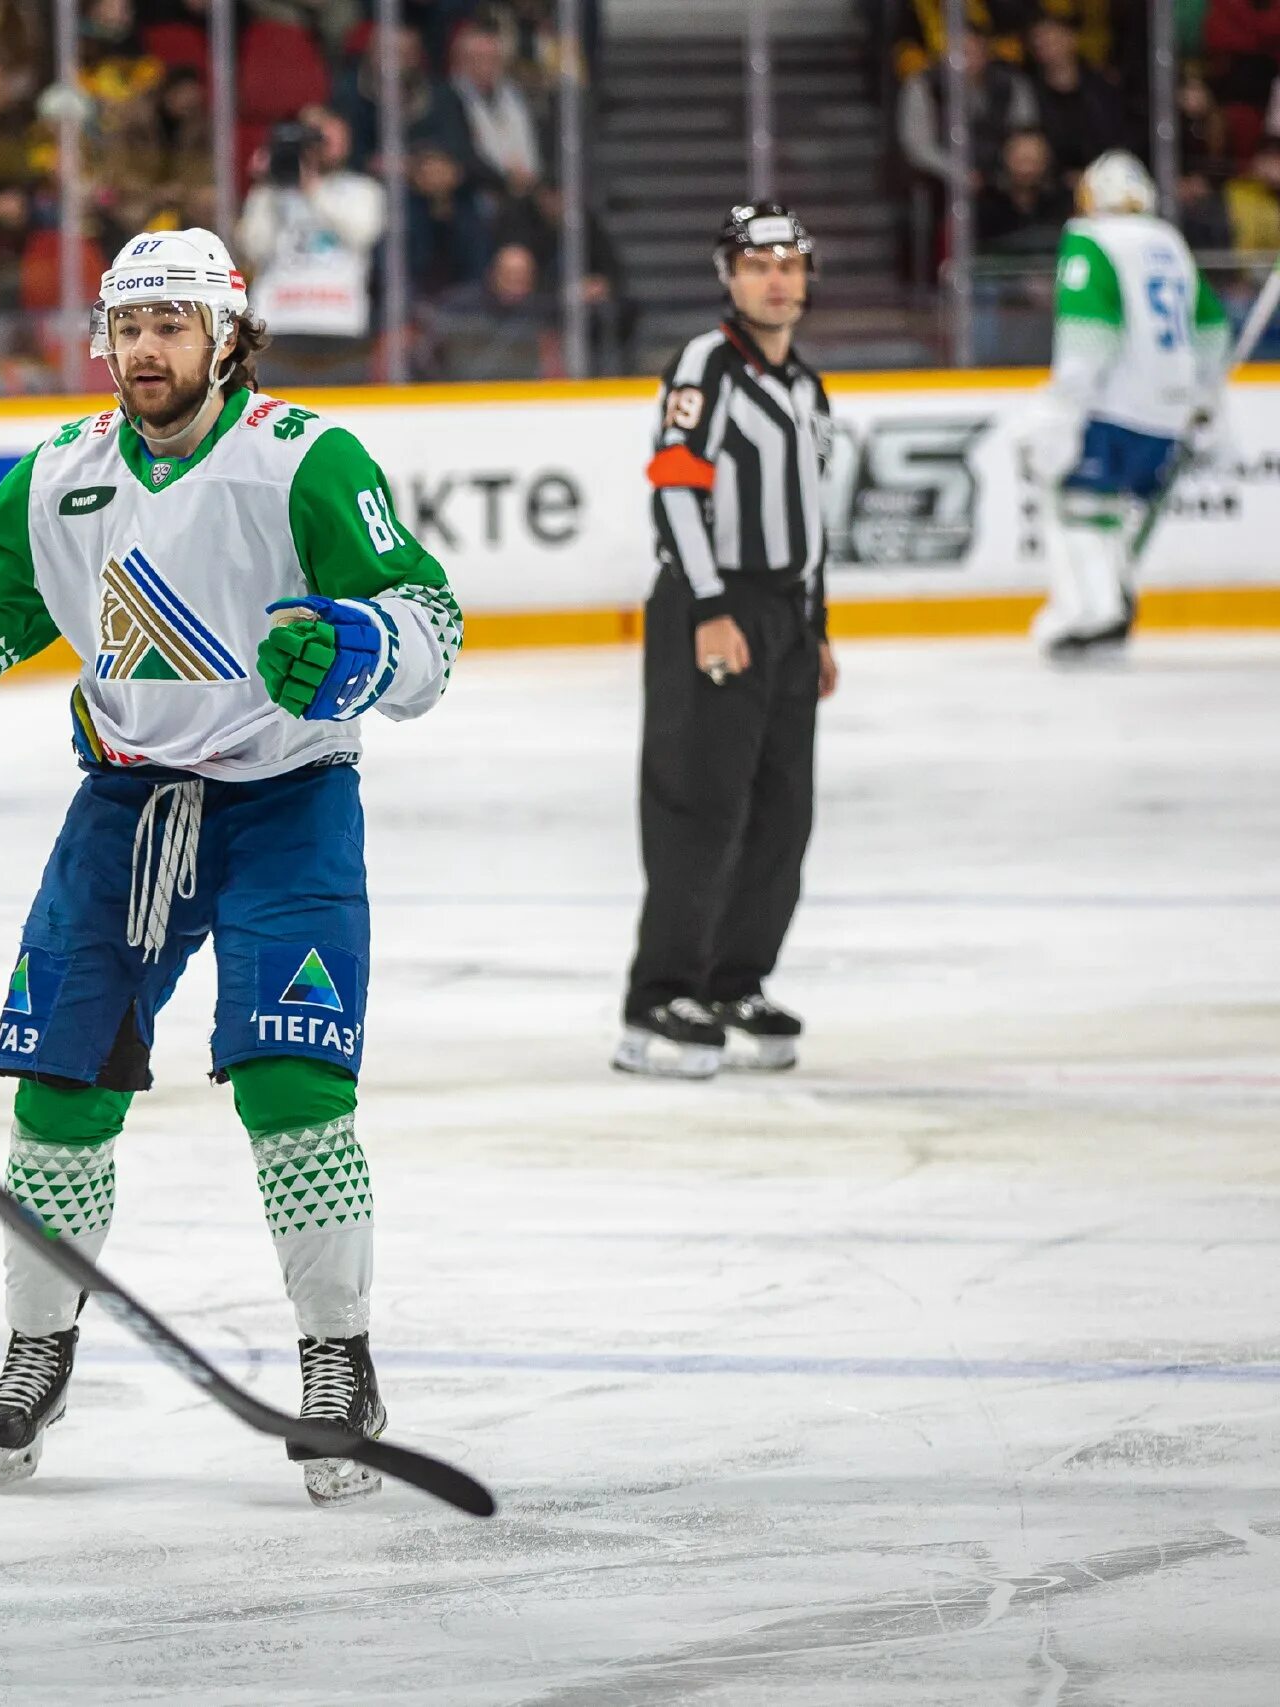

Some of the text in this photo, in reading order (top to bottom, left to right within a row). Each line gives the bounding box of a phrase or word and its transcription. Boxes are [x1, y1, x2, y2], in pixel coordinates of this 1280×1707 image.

[132, 240, 164, 256] 87
[116, 275, 165, 291] согаз
[92, 409, 114, 435] BET
[392, 468, 584, 550] кте
[258, 1014, 356, 1058] ПЕГАЗ
